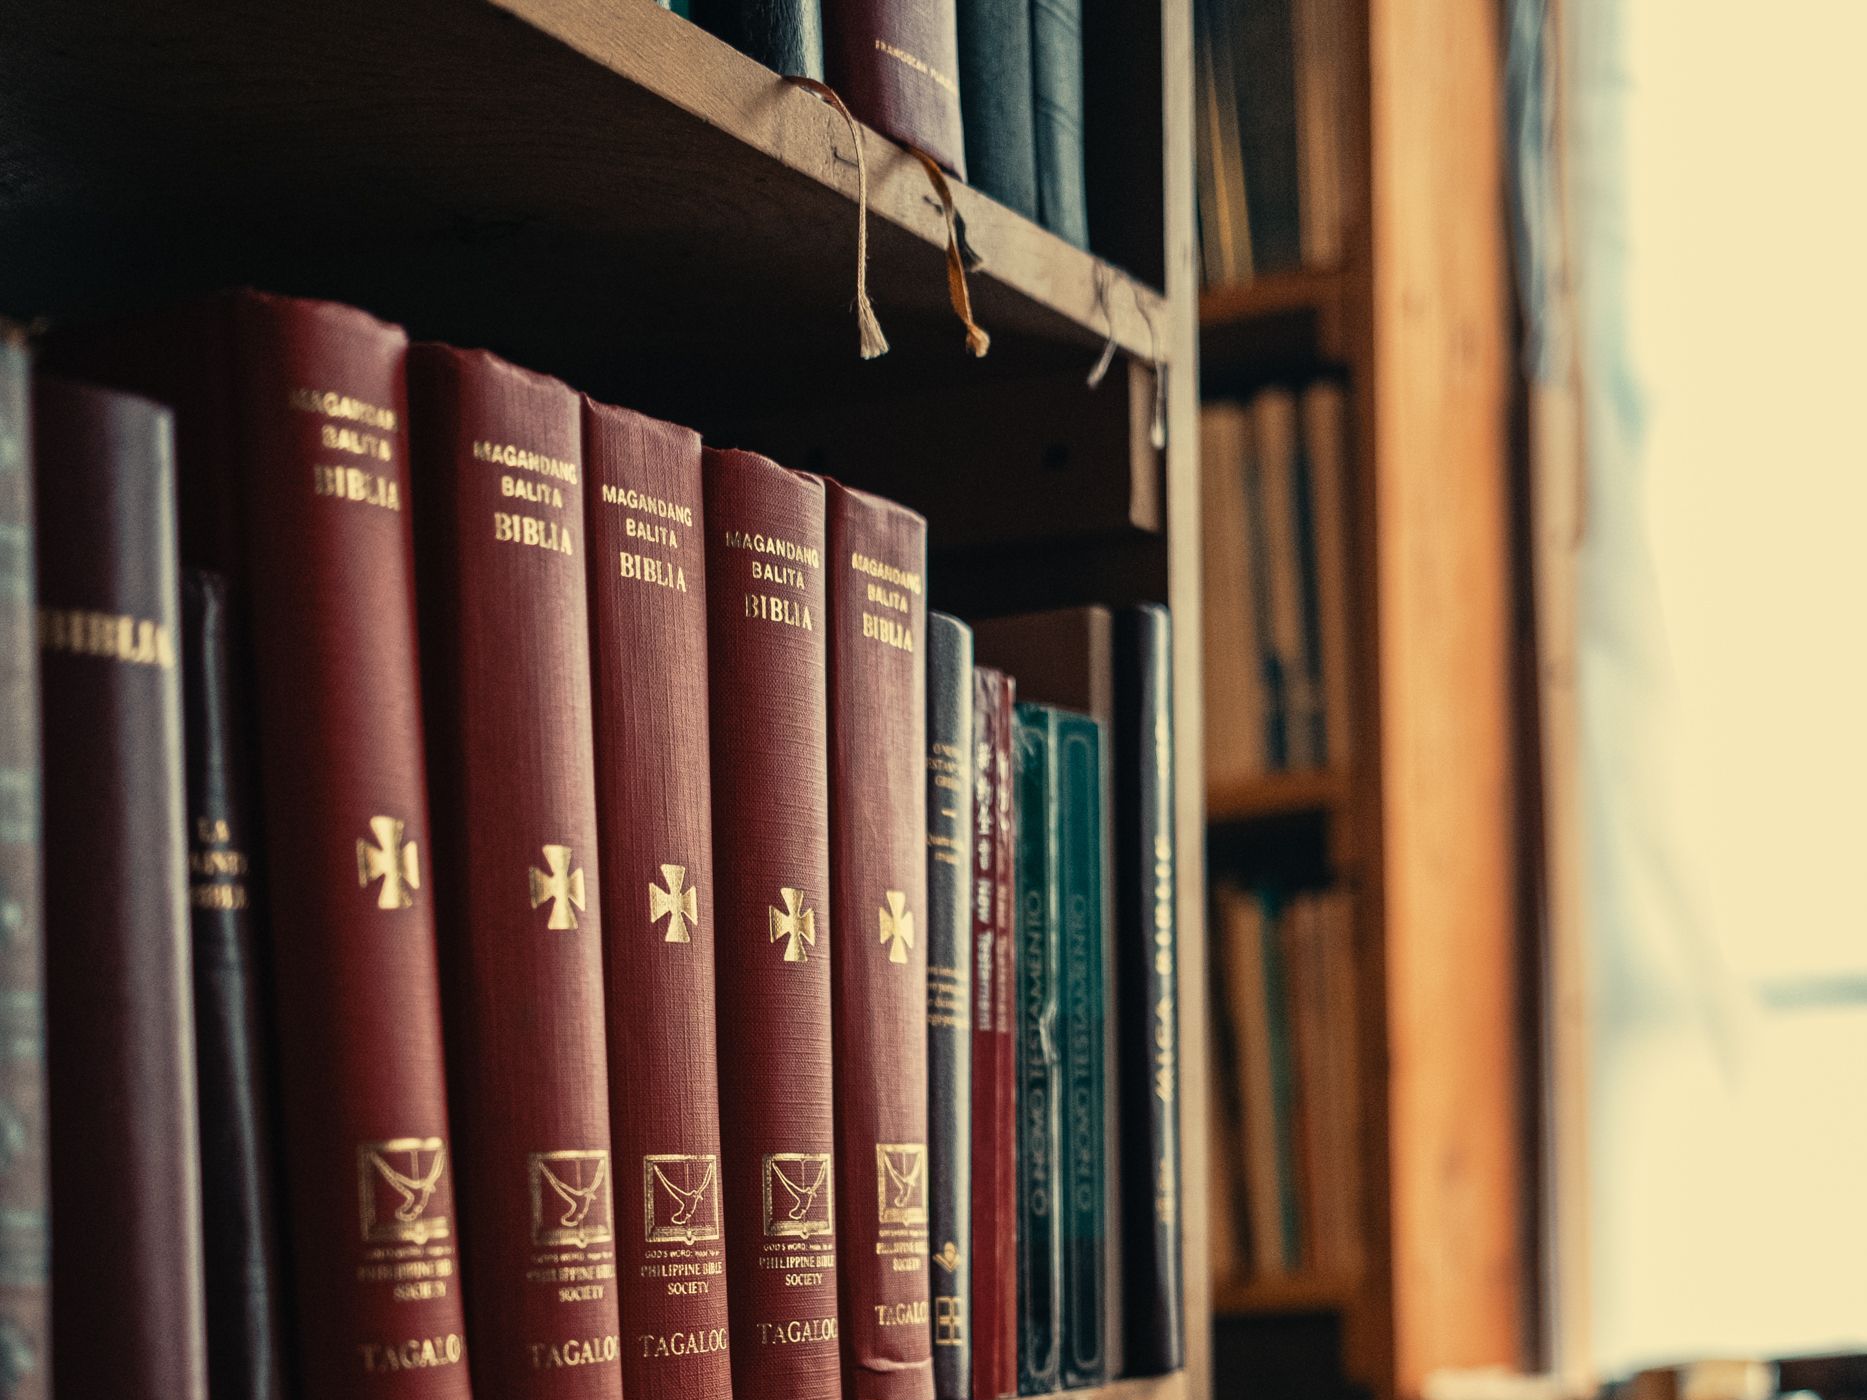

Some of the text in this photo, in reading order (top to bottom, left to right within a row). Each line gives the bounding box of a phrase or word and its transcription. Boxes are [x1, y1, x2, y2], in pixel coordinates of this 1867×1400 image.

[321, 424, 391, 461] BALITA
[473, 440, 577, 485] MAGANDANG
[501, 475, 562, 508] BALITA
[602, 484, 692, 527] MAGANDANG
[494, 511, 572, 555] BIBLIA
[626, 518, 677, 548] BALITA
[726, 531, 819, 568] MAGANDANG
[620, 551, 686, 592] BIBLIA
[752, 561, 805, 590] BALITA
[851, 552, 921, 595] MAGANDANG
[745, 592, 812, 631] BIBLIA
[867, 583, 908, 613] BALITA
[863, 611, 912, 653] BIBLIA
[640, 1263, 702, 1278] PHILIPPINE
[667, 1281, 709, 1295] SOCIETY
[785, 1272, 823, 1286] SOCIETY
[638, 1328, 727, 1358] TAGALOG
